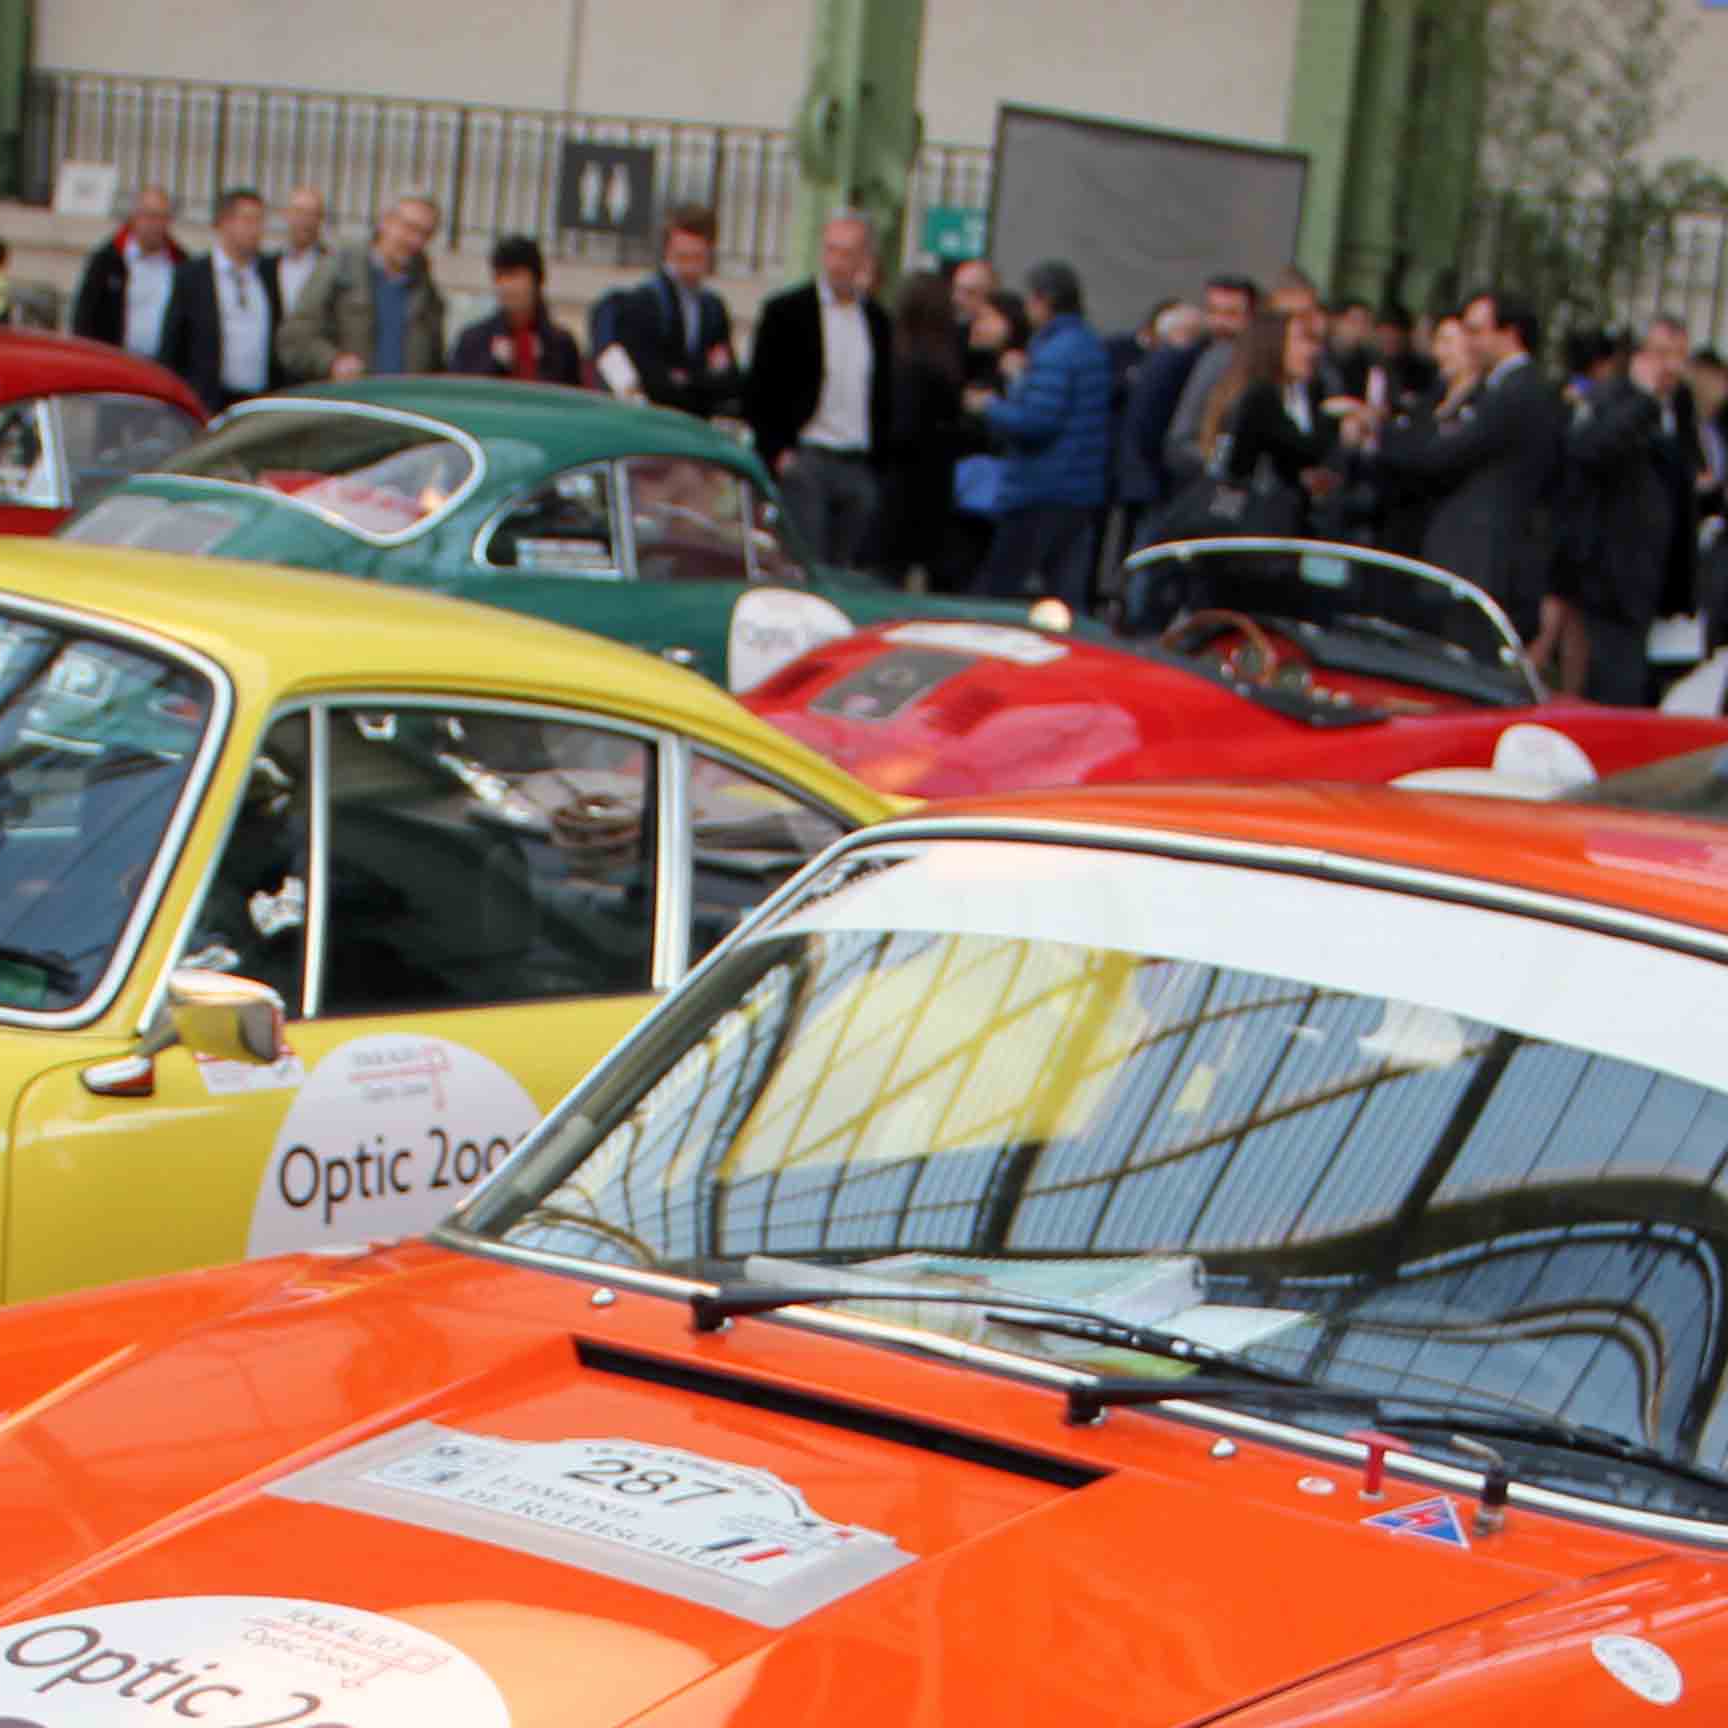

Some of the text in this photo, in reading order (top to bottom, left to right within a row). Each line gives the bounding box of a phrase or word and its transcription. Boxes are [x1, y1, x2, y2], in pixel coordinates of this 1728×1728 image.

[279, 1127, 529, 1224] Optic 200
[561, 1458, 736, 1506] 287
[3, 1622, 247, 1719] Optic
